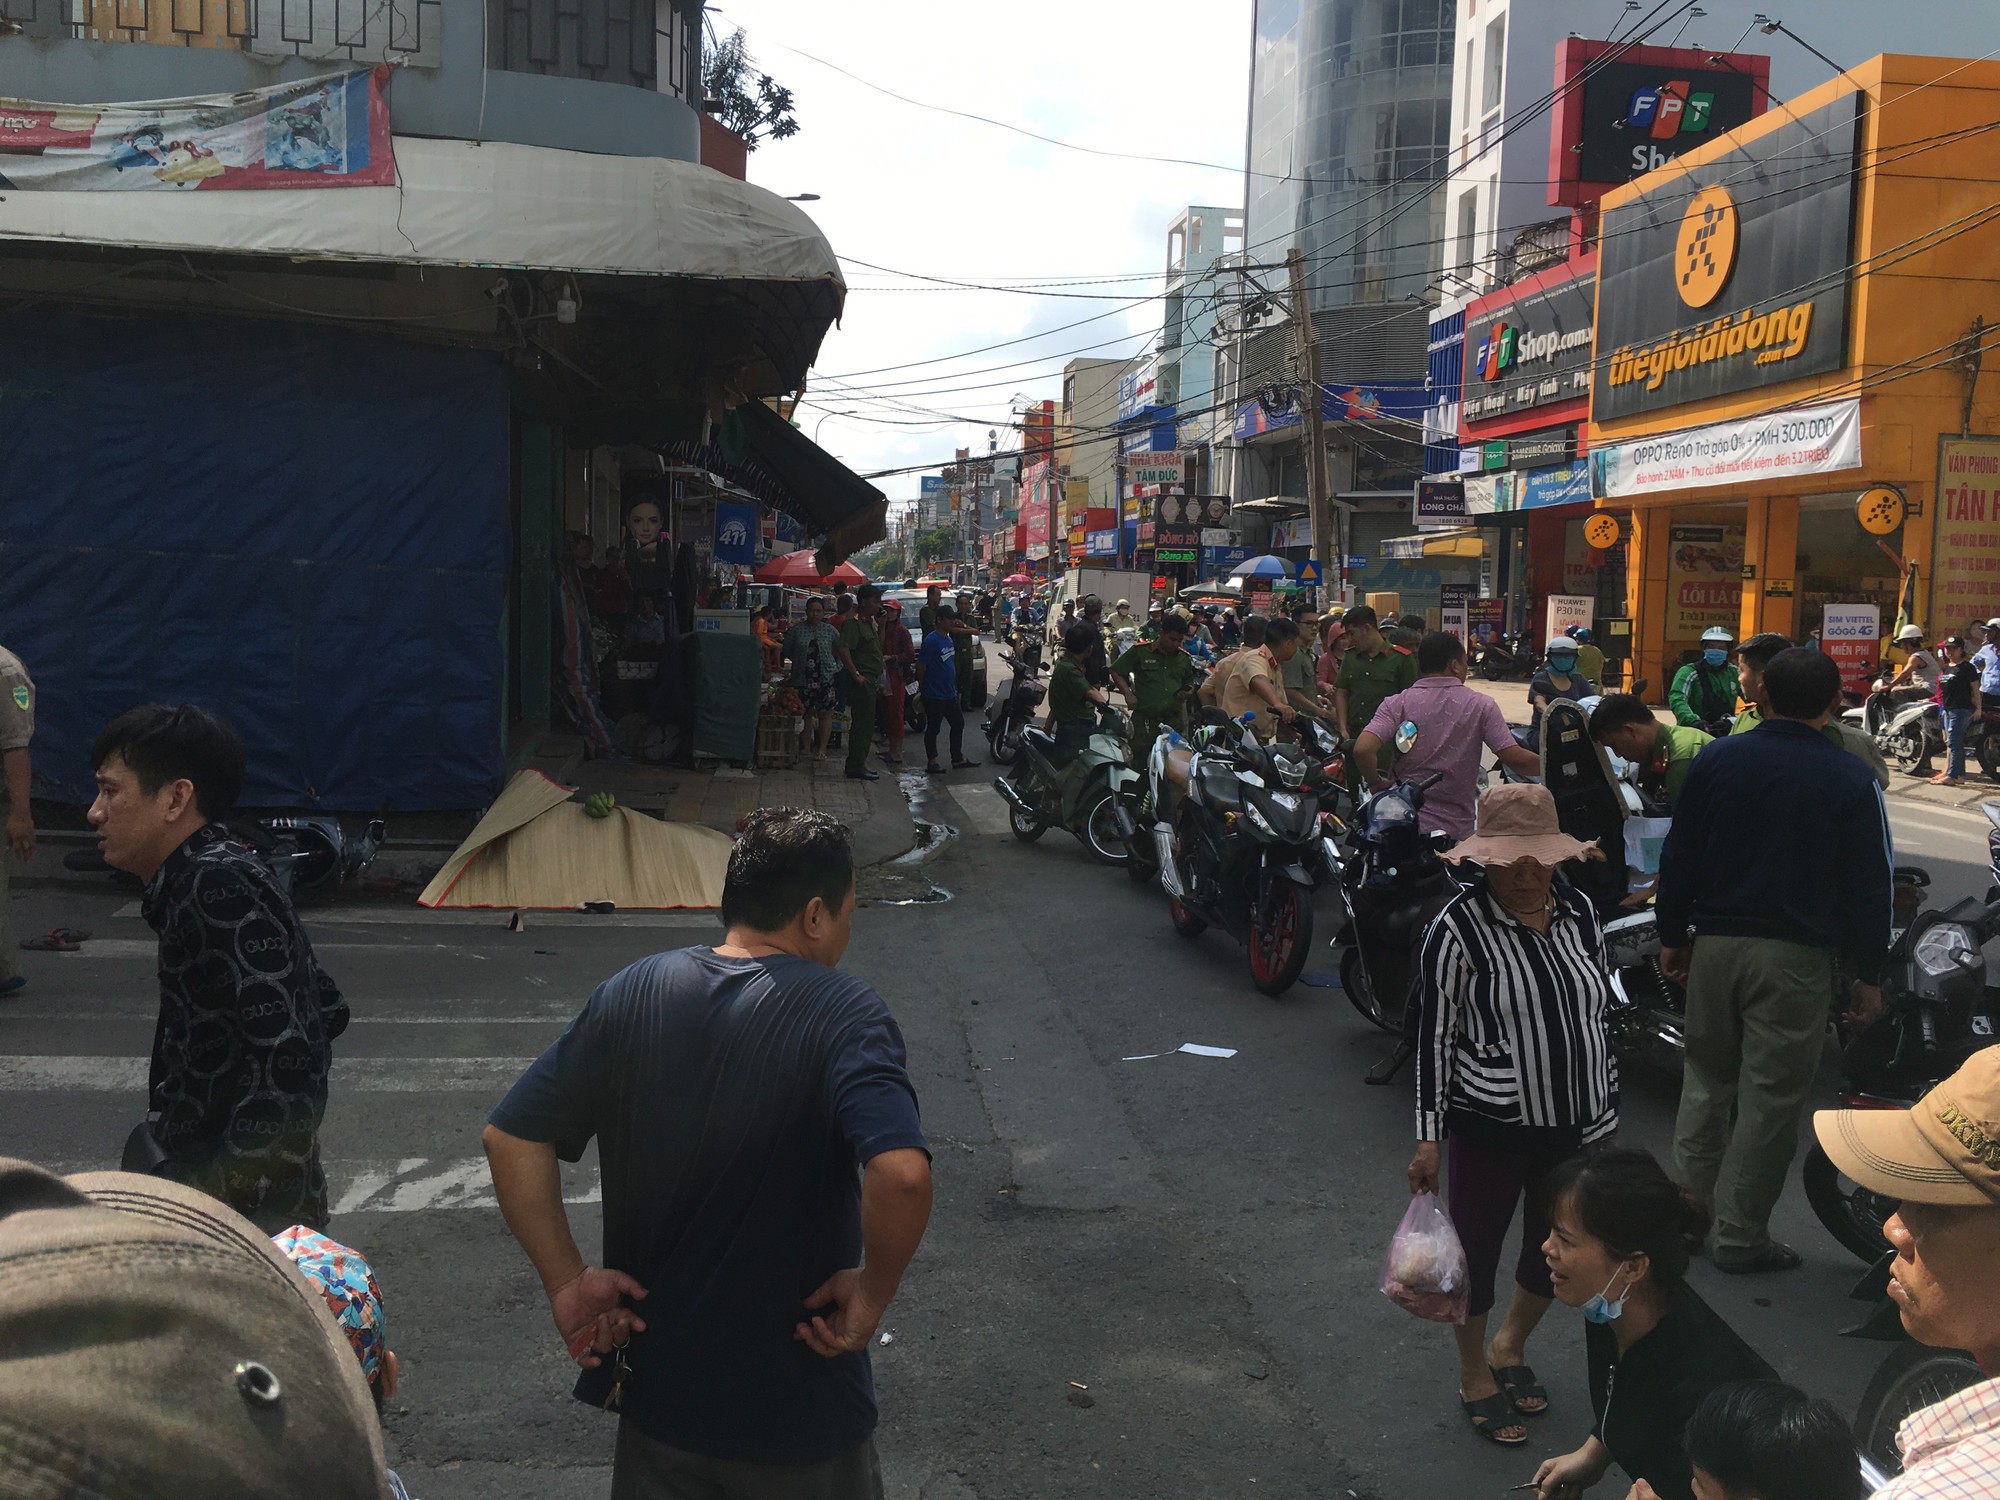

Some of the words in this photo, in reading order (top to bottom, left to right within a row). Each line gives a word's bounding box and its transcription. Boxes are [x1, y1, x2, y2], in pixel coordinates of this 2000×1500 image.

[1633, 96, 1709, 122] FPT
[1477, 337, 1510, 367] FPT
[1609, 301, 1814, 391] thegioididong
[1463, 399, 1481, 418] Điện
[1483, 391, 1507, 412] thoại
[1516, 384, 1537, 405] Máy
[1540, 377, 1560, 397] tính
[1633, 444, 1662, 465] OPPO
[1665, 443, 1693, 460] Reno
[1696, 439, 1710, 456] Trả
[1711, 438, 1729, 458] góp
[1755, 428, 1780, 447] PMH
[1782, 417, 1834, 443] 300.000
[1130, 453, 1151, 466] NHA
[1153, 453, 1182, 466] KHOA
[1948, 452, 1966, 473] VĂN
[1968, 452, 1999, 474] PHÒNG
[1135, 468, 1156, 482] TÂM
[1158, 467, 1178, 482] ĐỨC
[1421, 503, 1445, 511] LONG
[1945, 482, 1986, 521] TÂN
[719, 530, 747, 545] 411
[1159, 529, 1184, 544] ĐỒNG
[1185, 530, 1199, 544] HỒ
[1710, 581, 1728, 604] LÀ
[1556, 606, 1572, 615] P30
[1574, 606, 1586, 616] lite
[1443, 615, 1462, 625] MUA
[1846, 616, 1874, 624] VIETTEL
[1858, 626, 1873, 636] 4G
[1831, 642, 1852, 655] MIỄN
[1855, 643, 1870, 655] PHÍ
